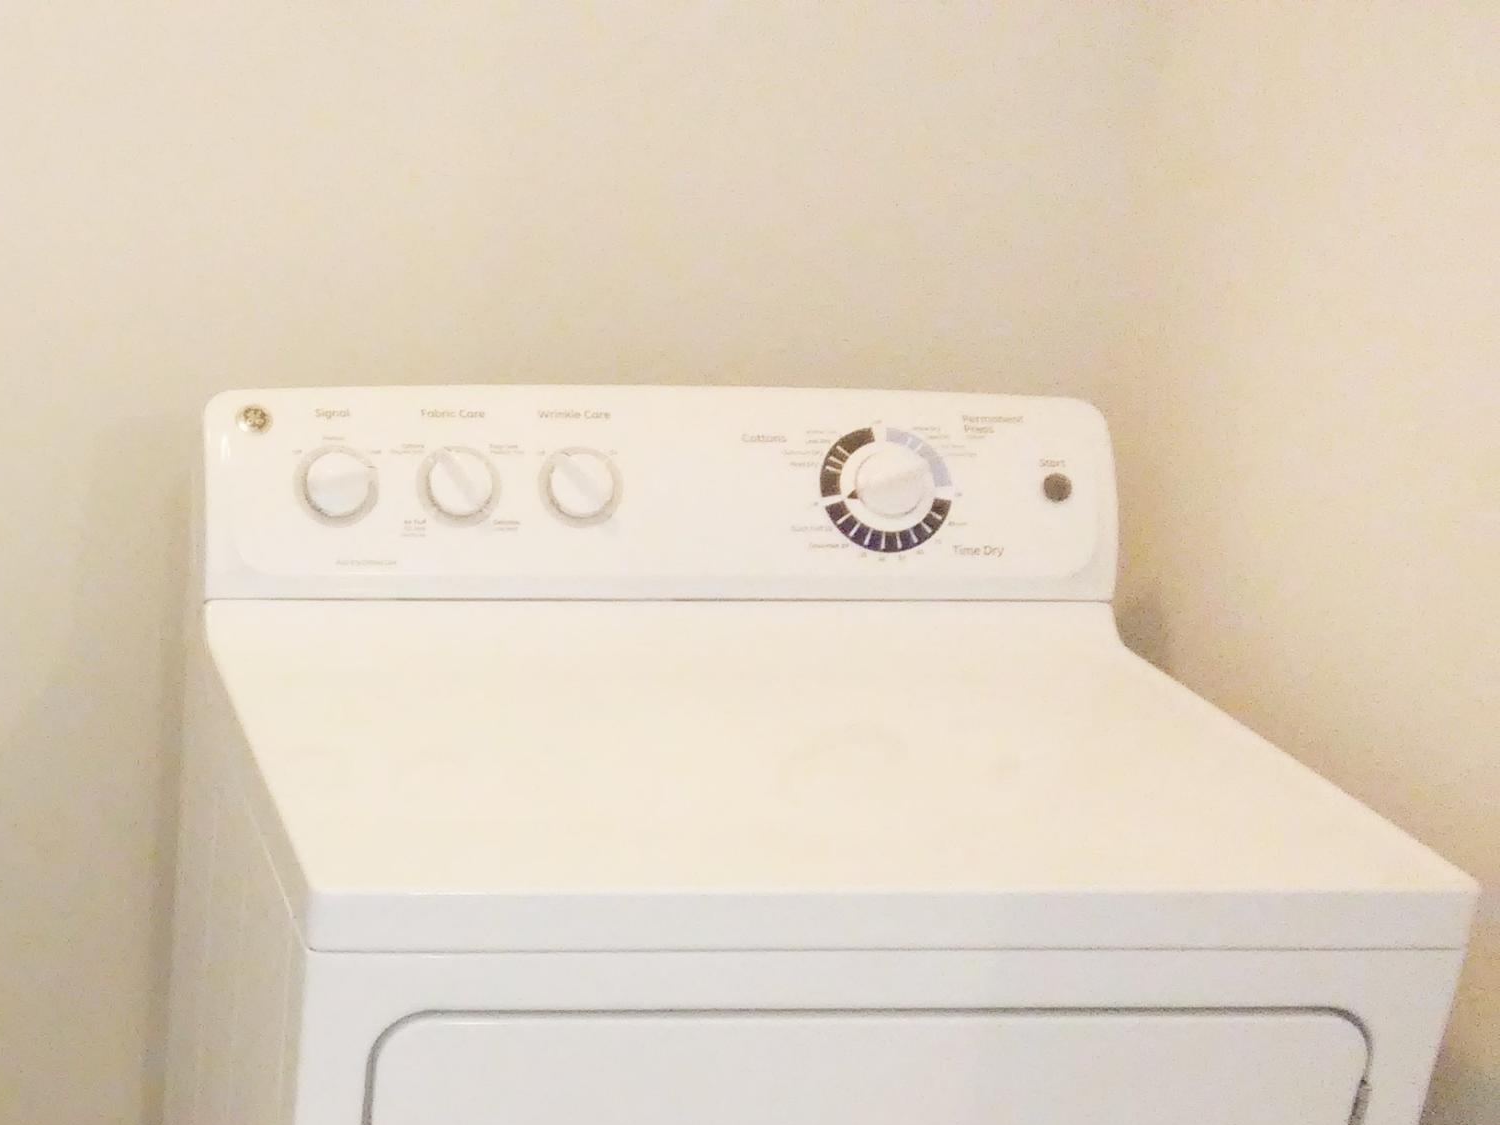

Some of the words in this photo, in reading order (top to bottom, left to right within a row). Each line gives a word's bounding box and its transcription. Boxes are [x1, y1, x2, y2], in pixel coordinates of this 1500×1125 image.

[315, 408, 350, 420] Signal
[420, 408, 457, 418] Fabric
[459, 408, 485, 418] Care
[538, 409, 582, 419] Wrinkle
[583, 409, 611, 420] Care
[740, 433, 788, 443] Cottons
[1038, 458, 1067, 468] Start
[952, 544, 981, 556] Time
[983, 544, 1005, 558] Dry
